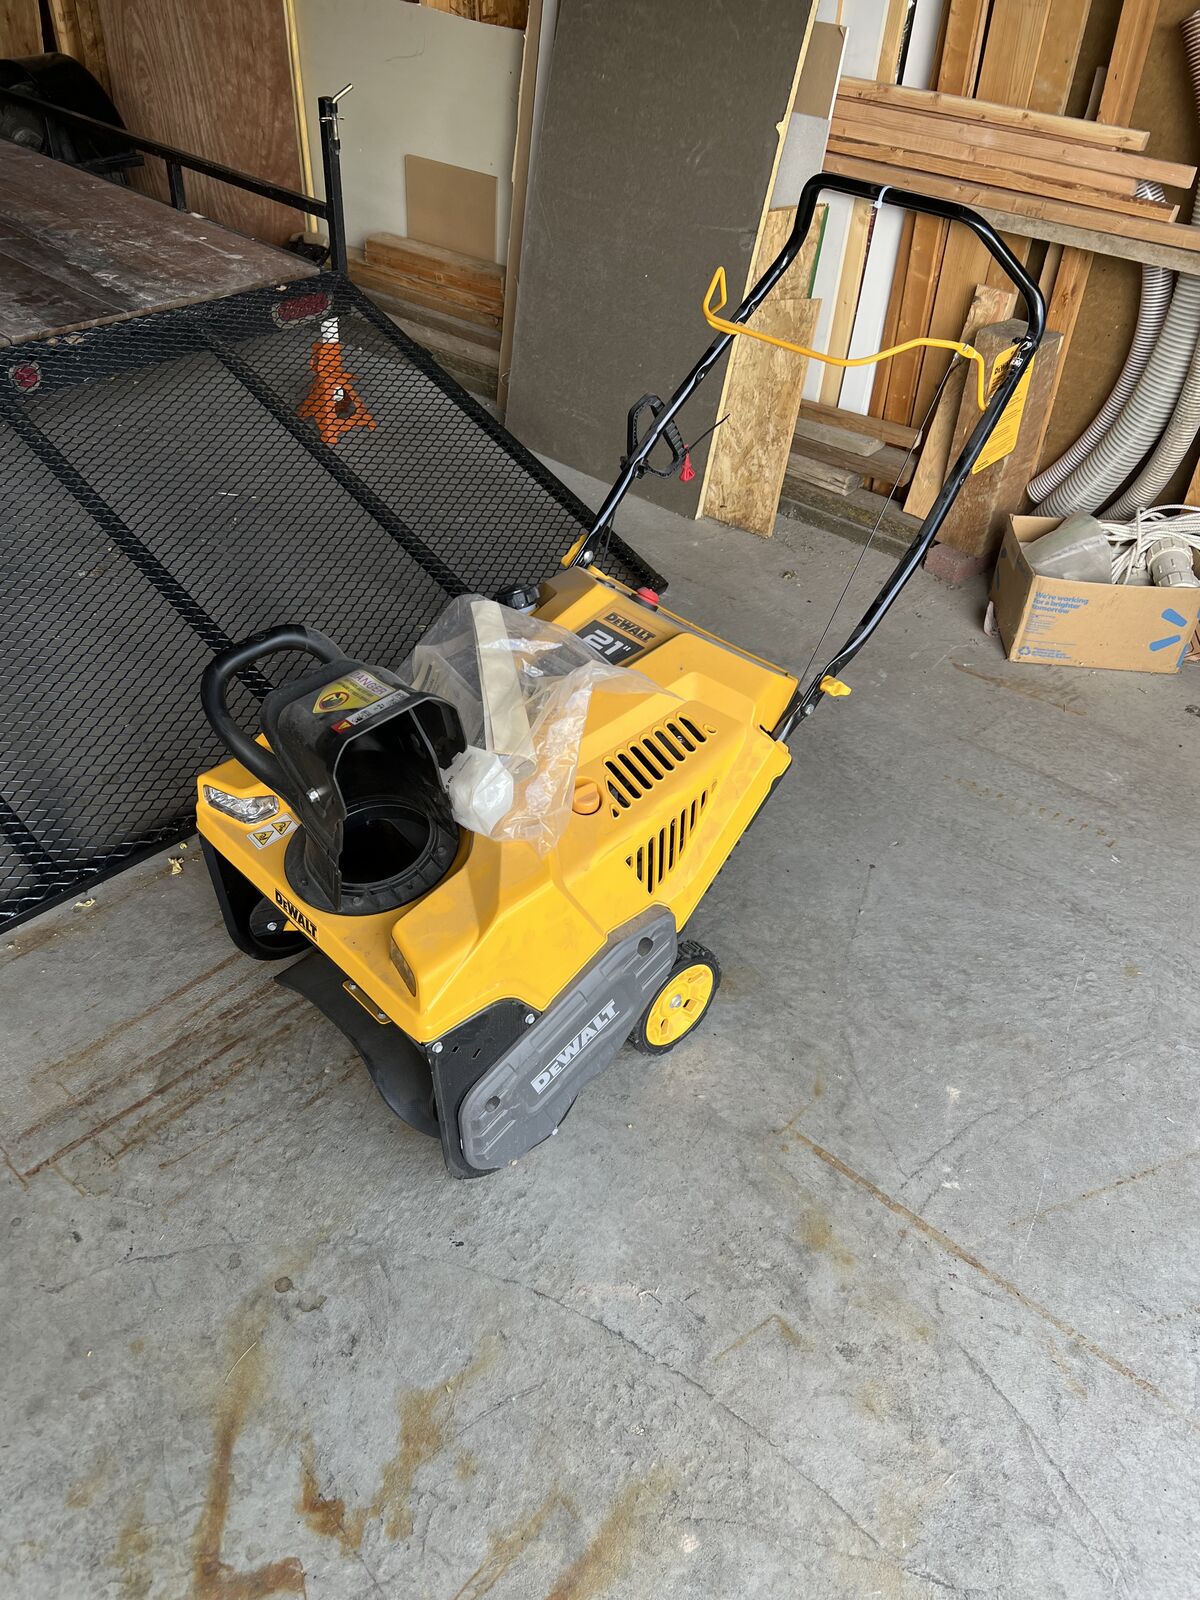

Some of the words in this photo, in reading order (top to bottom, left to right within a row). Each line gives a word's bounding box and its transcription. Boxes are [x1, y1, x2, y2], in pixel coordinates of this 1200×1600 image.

[1031, 604, 1070, 614] tomorrow
[1050, 601, 1080, 609] brighter
[1058, 595, 1089, 605] working
[582, 629, 631, 656] 21"
[351, 671, 388, 695] DANGER
[275, 887, 317, 937] DEWALT
[530, 998, 620, 1095] DEWALT
